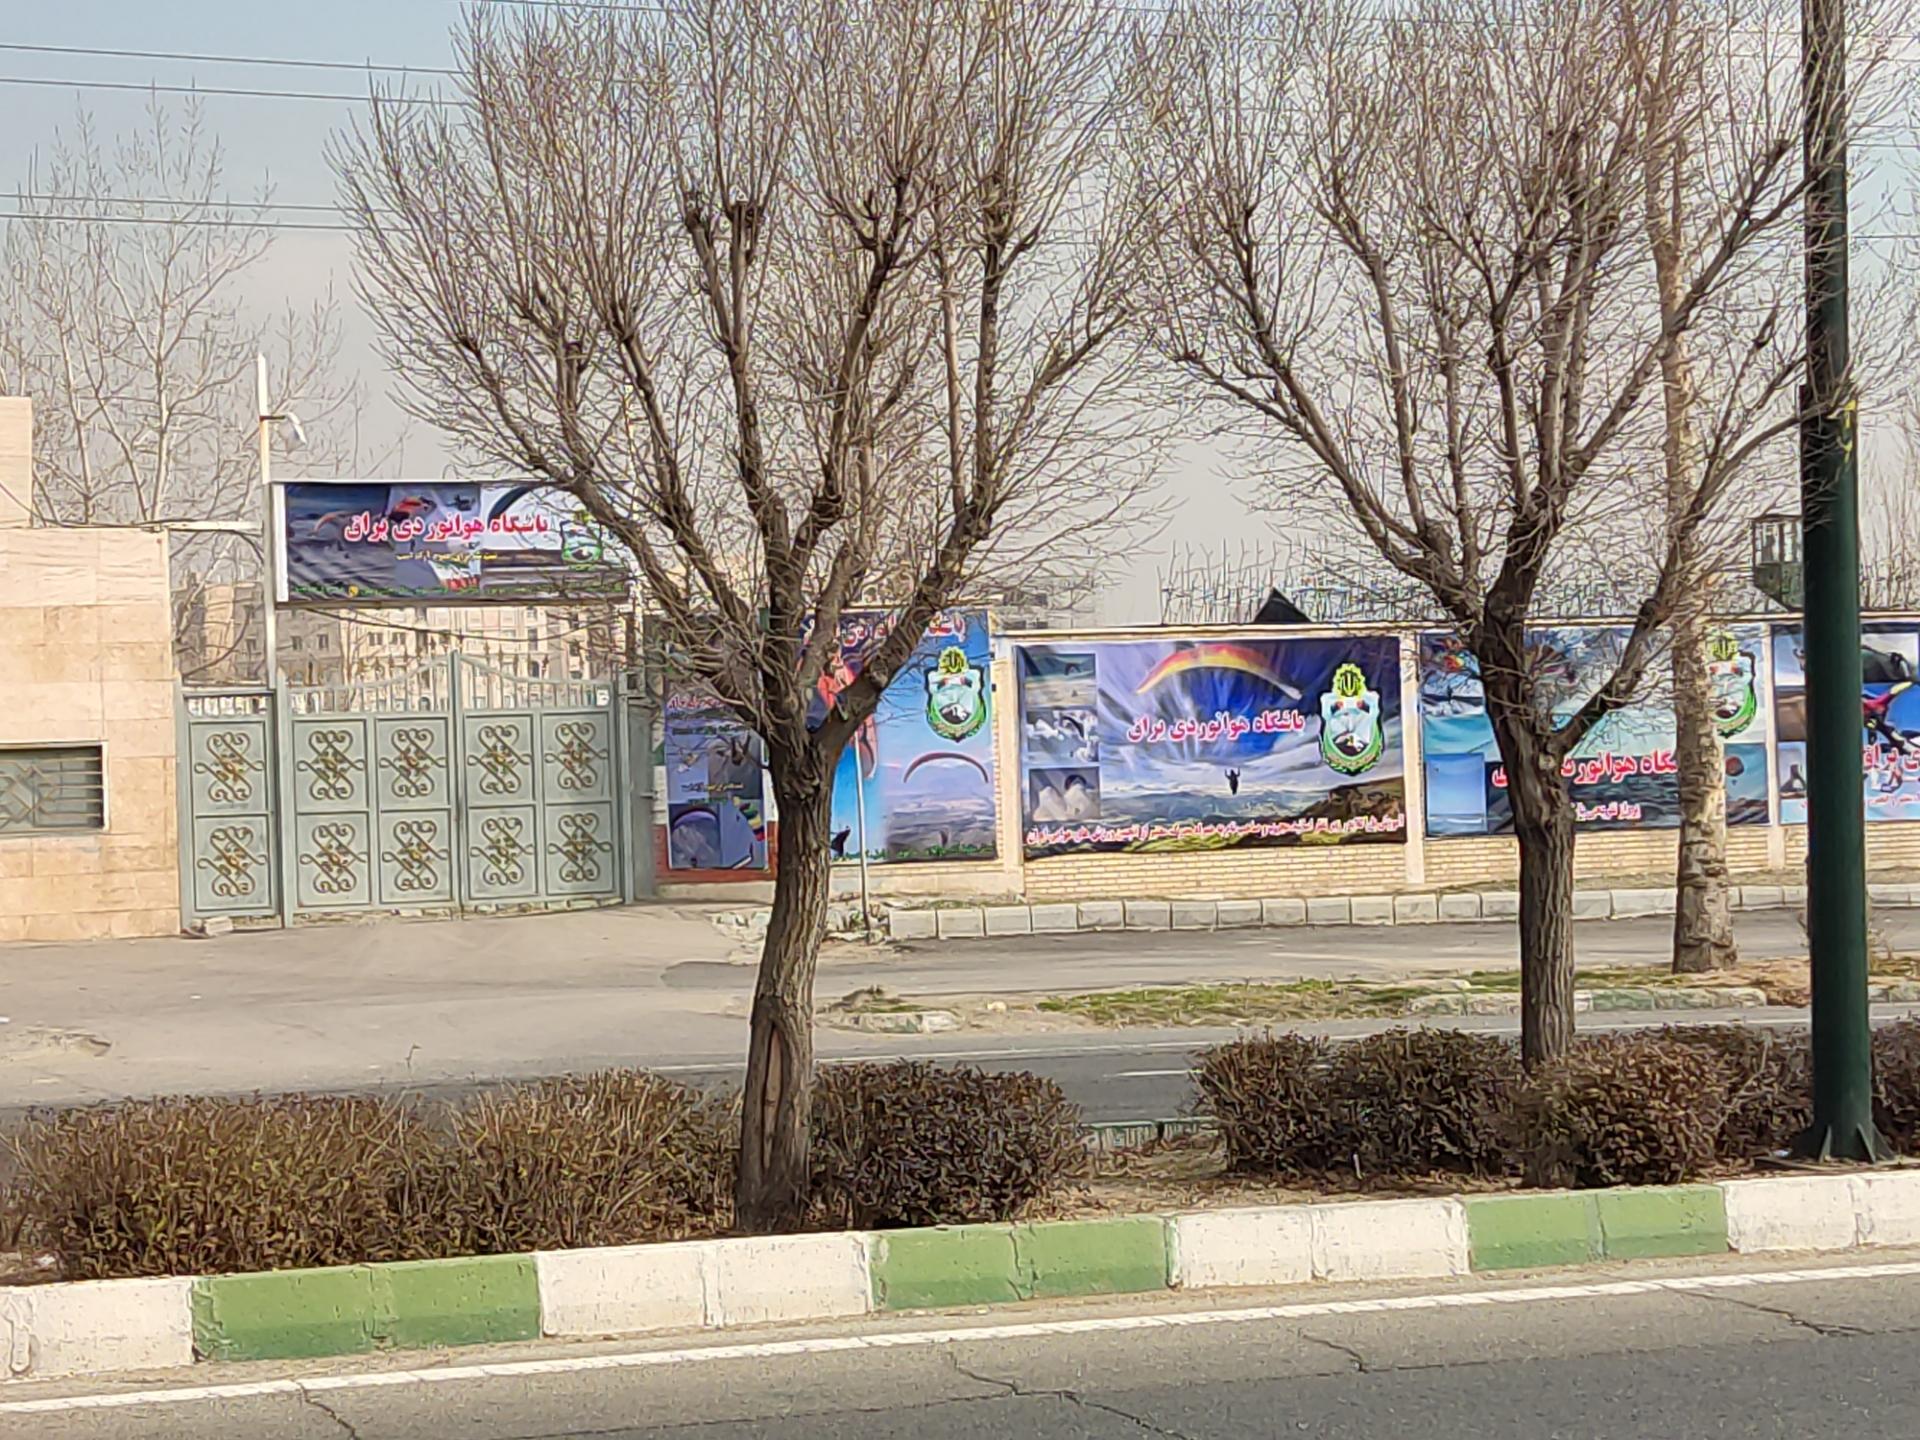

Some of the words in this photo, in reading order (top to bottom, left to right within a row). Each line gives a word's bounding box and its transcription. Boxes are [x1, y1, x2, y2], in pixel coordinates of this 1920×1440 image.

[391, 512, 485, 541] هوانوردی
[488, 513, 549, 534] باشگاه
[1169, 710, 1249, 741] هوانوردی
[1252, 709, 1306, 733] باشگاه
[1560, 751, 1638, 785] هوانورد
